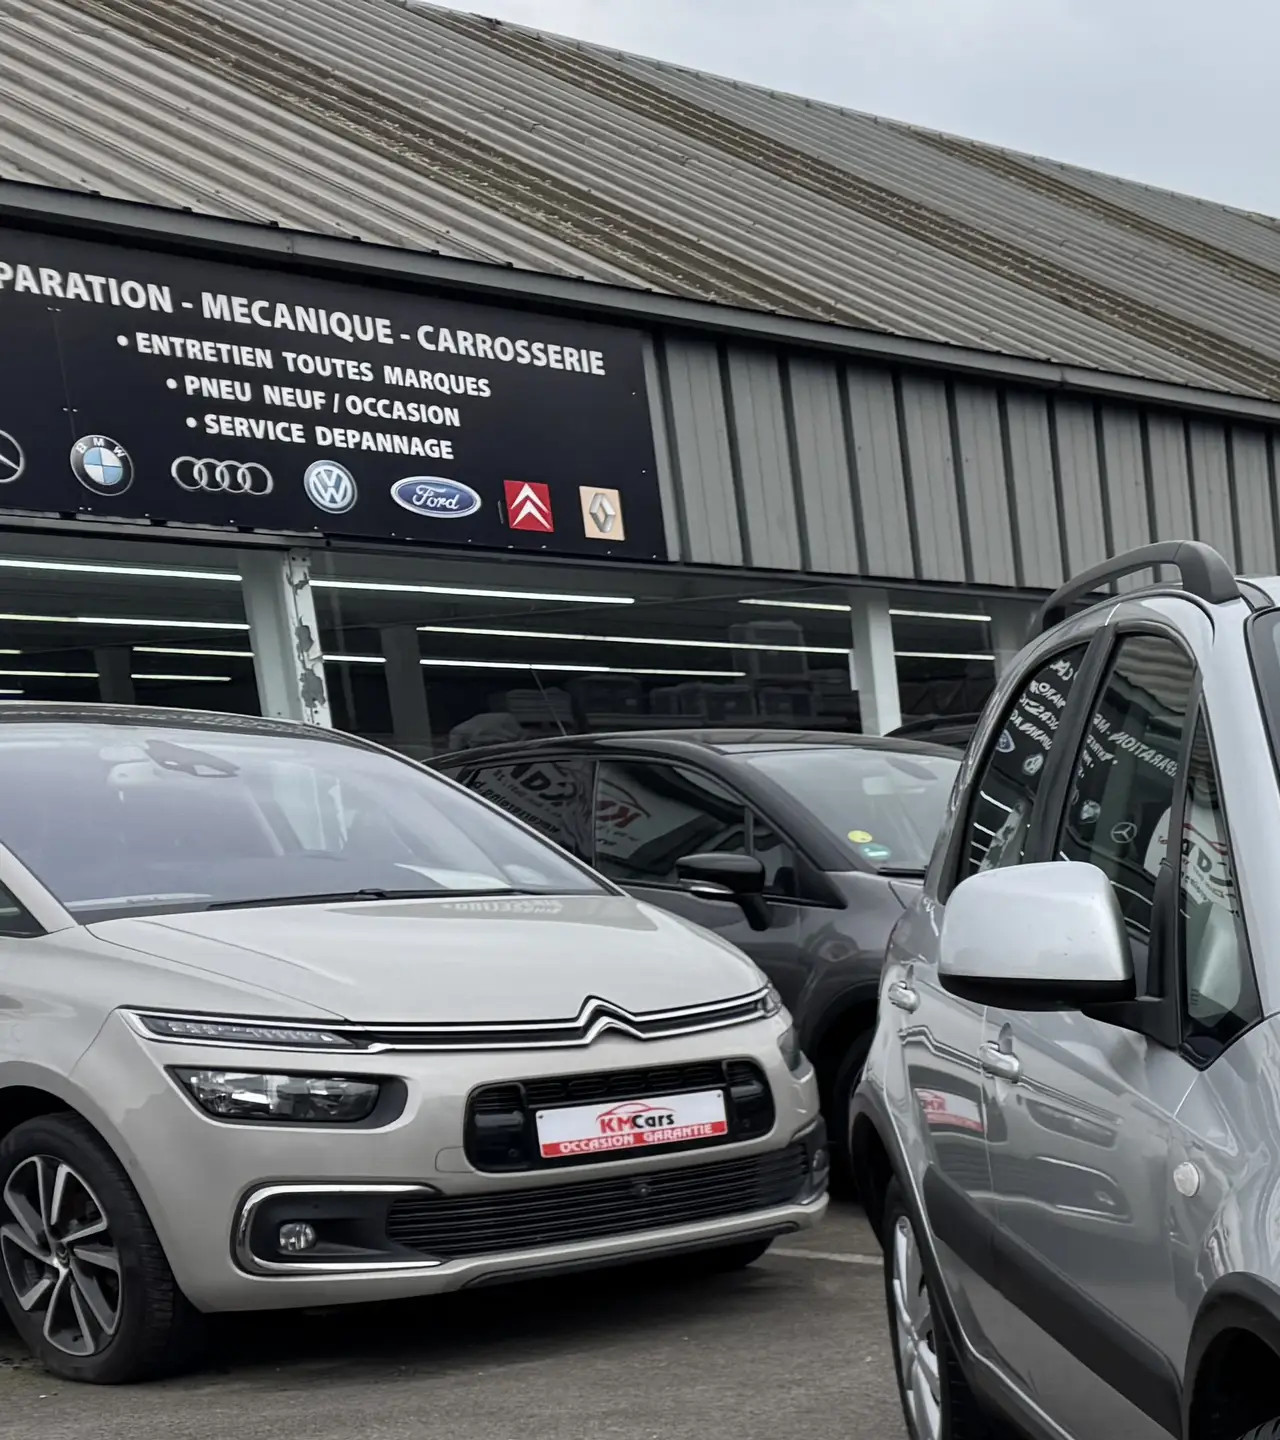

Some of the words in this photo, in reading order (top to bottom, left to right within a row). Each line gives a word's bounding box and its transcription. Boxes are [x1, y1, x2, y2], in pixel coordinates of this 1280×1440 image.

[201, 291, 394, 345] MECANIQUE
[417, 324, 606, 376] CARROSSERIE
[136, 331, 274, 370] ENTRETIEN
[282, 350, 374, 383] TOUTES
[384, 364, 492, 398] MARQUES
[184, 374, 252, 402] PNEU
[263, 384, 327, 410] NEUF
[345, 394, 461, 428] OCCASION
[204, 413, 306, 444] SERVICE
[315, 425, 455, 460] DEPANNAGE
[412, 484, 460, 510] Ford
[559, 1134, 634, 1153] OCCASION
[643, 1123, 713, 1144] GARANTIE
[600, 1113, 675, 1134] KMCars
